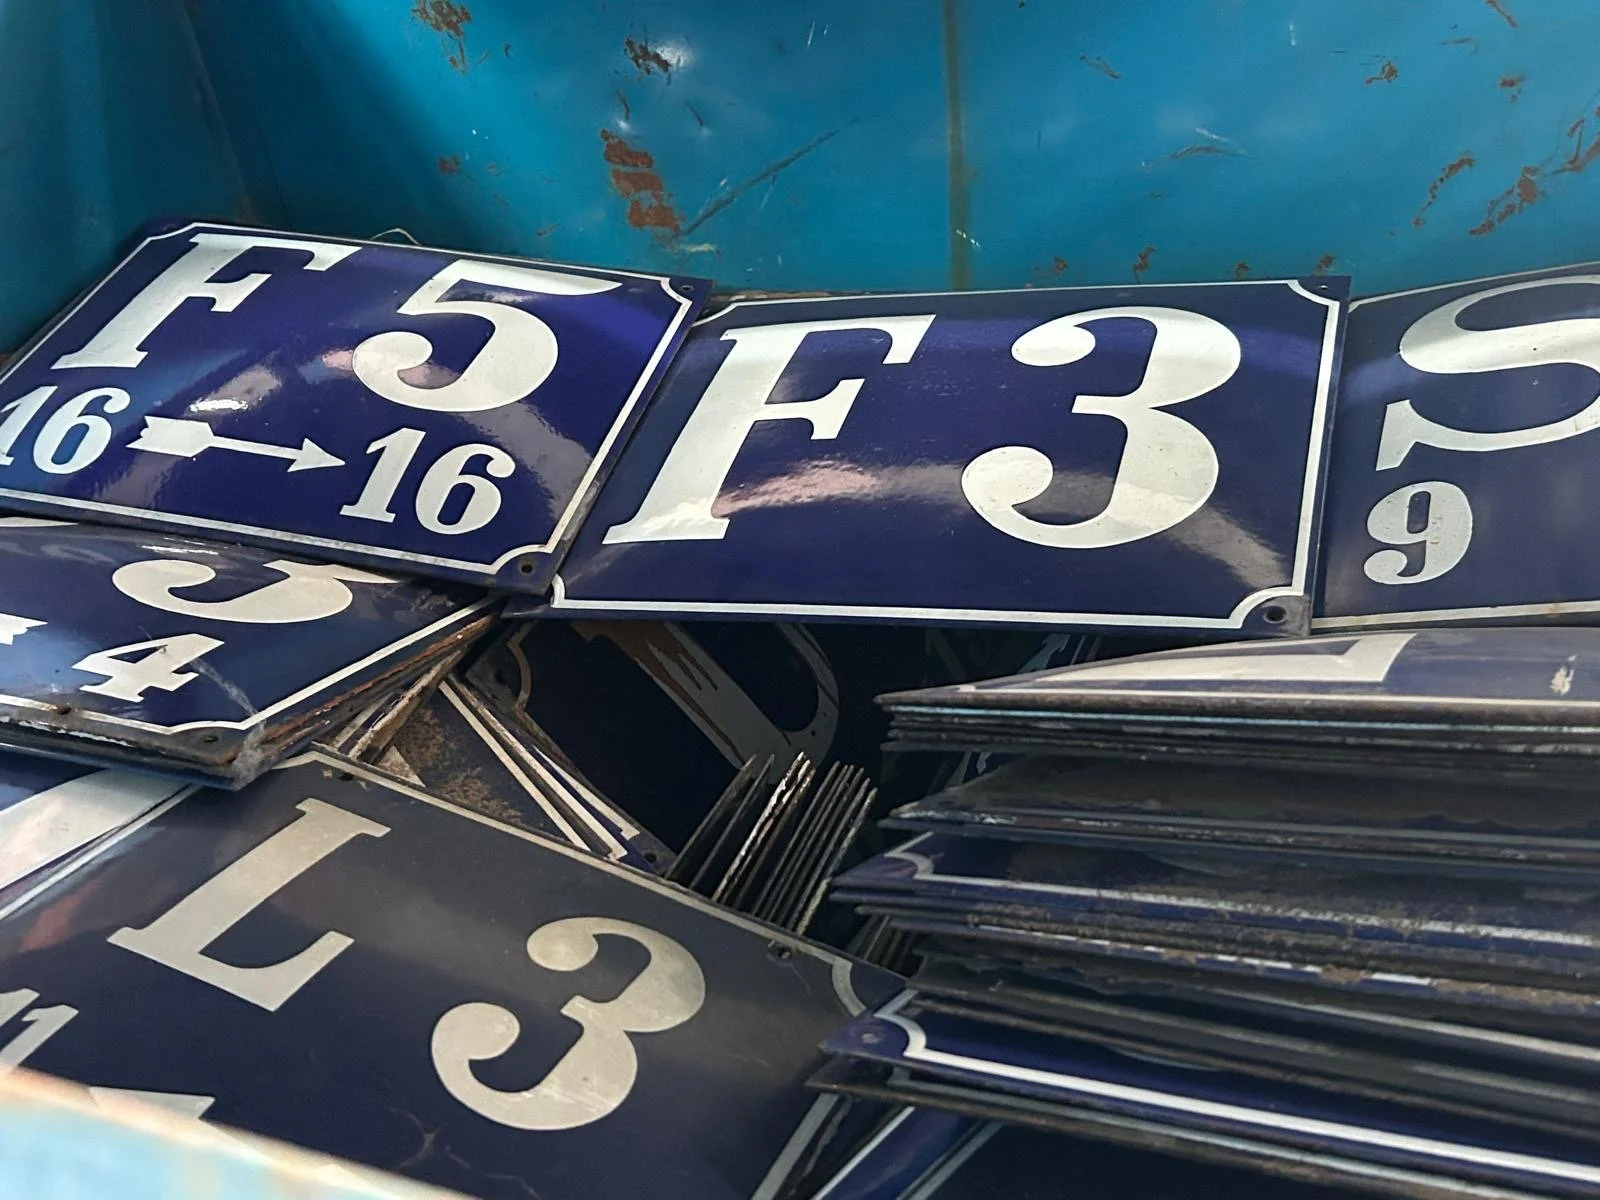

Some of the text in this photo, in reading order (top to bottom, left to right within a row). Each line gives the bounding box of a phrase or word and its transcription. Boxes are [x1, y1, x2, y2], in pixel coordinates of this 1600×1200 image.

[51, 233, 622, 412] F 5
[0, 385, 516, 535] 16 16
[603, 305, 1241, 549] F 3
[1364, 481, 1473, 585] 9
[72, 633, 224, 703] 4
[107, 798, 391, 1012] L
[431, 916, 706, 1131] 3
